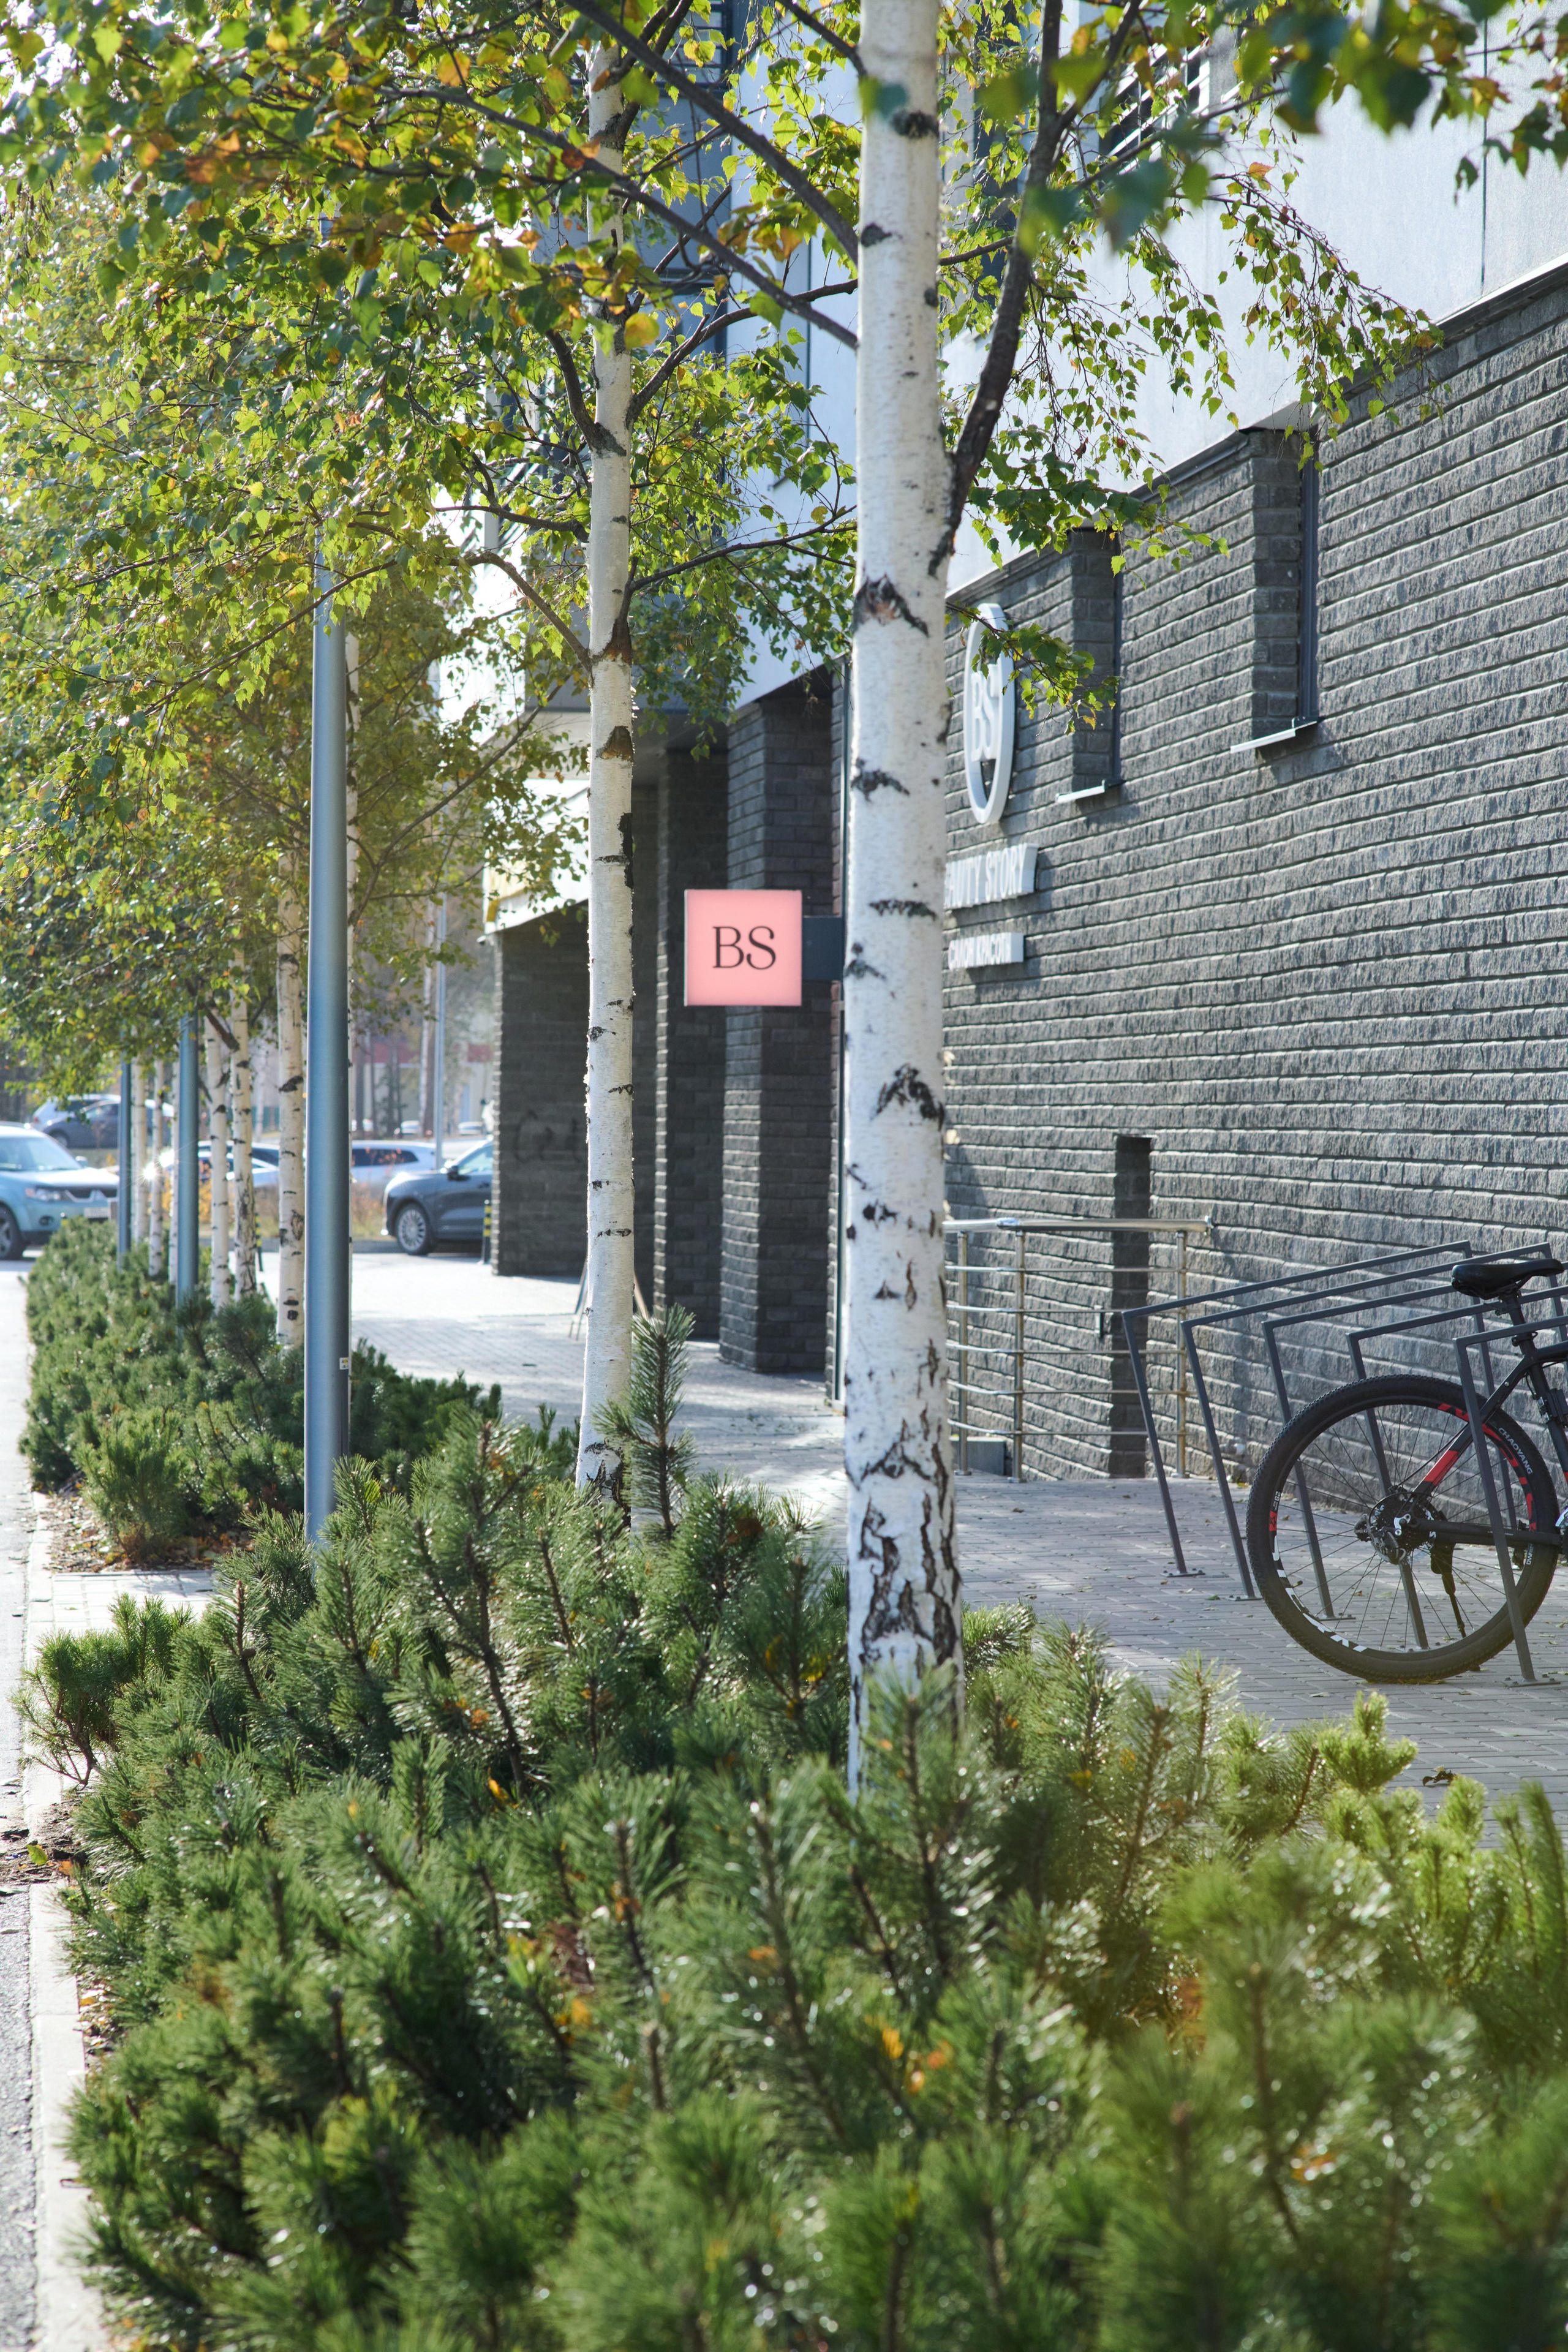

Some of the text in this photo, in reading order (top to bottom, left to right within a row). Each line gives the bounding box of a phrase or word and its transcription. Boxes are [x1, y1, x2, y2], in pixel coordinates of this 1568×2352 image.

[971, 663, 999, 762] BS
[944, 842, 1027, 908] AUTY STORY
[712, 925, 776, 970] BS
[1498, 1427, 1533, 1474] CHAOYANG
